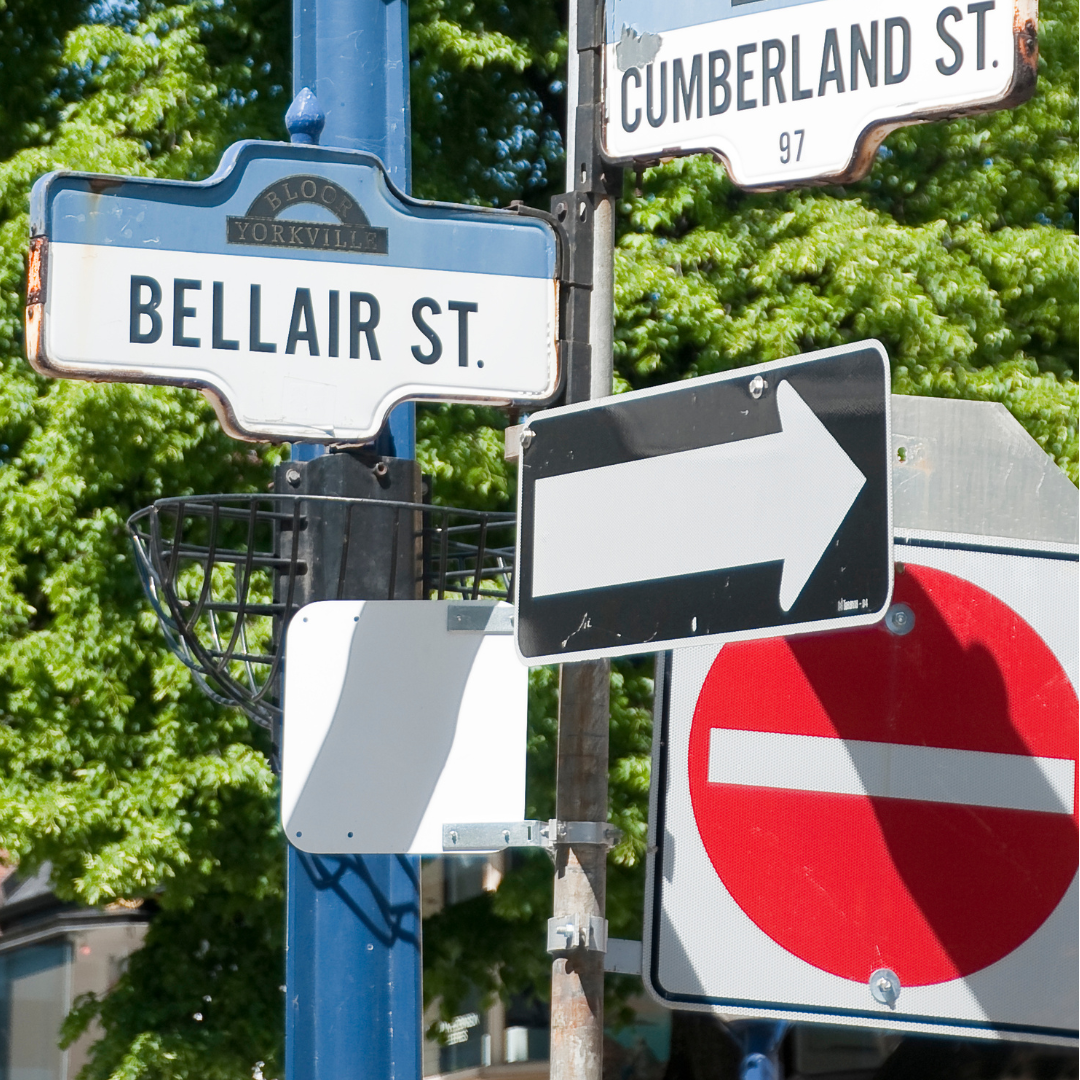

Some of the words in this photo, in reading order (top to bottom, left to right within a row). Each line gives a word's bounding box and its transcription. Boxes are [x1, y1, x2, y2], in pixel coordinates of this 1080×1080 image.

[620, 15, 912, 134] CUMBERLAND
[935, 0, 999, 76] ST.
[778, 128, 806, 165] 97
[263, 179, 353, 219] BLOOR
[234, 221, 378, 251] YORKVILLE
[129, 274, 381, 361] BELLAIR
[410, 296, 485, 369] ST.
